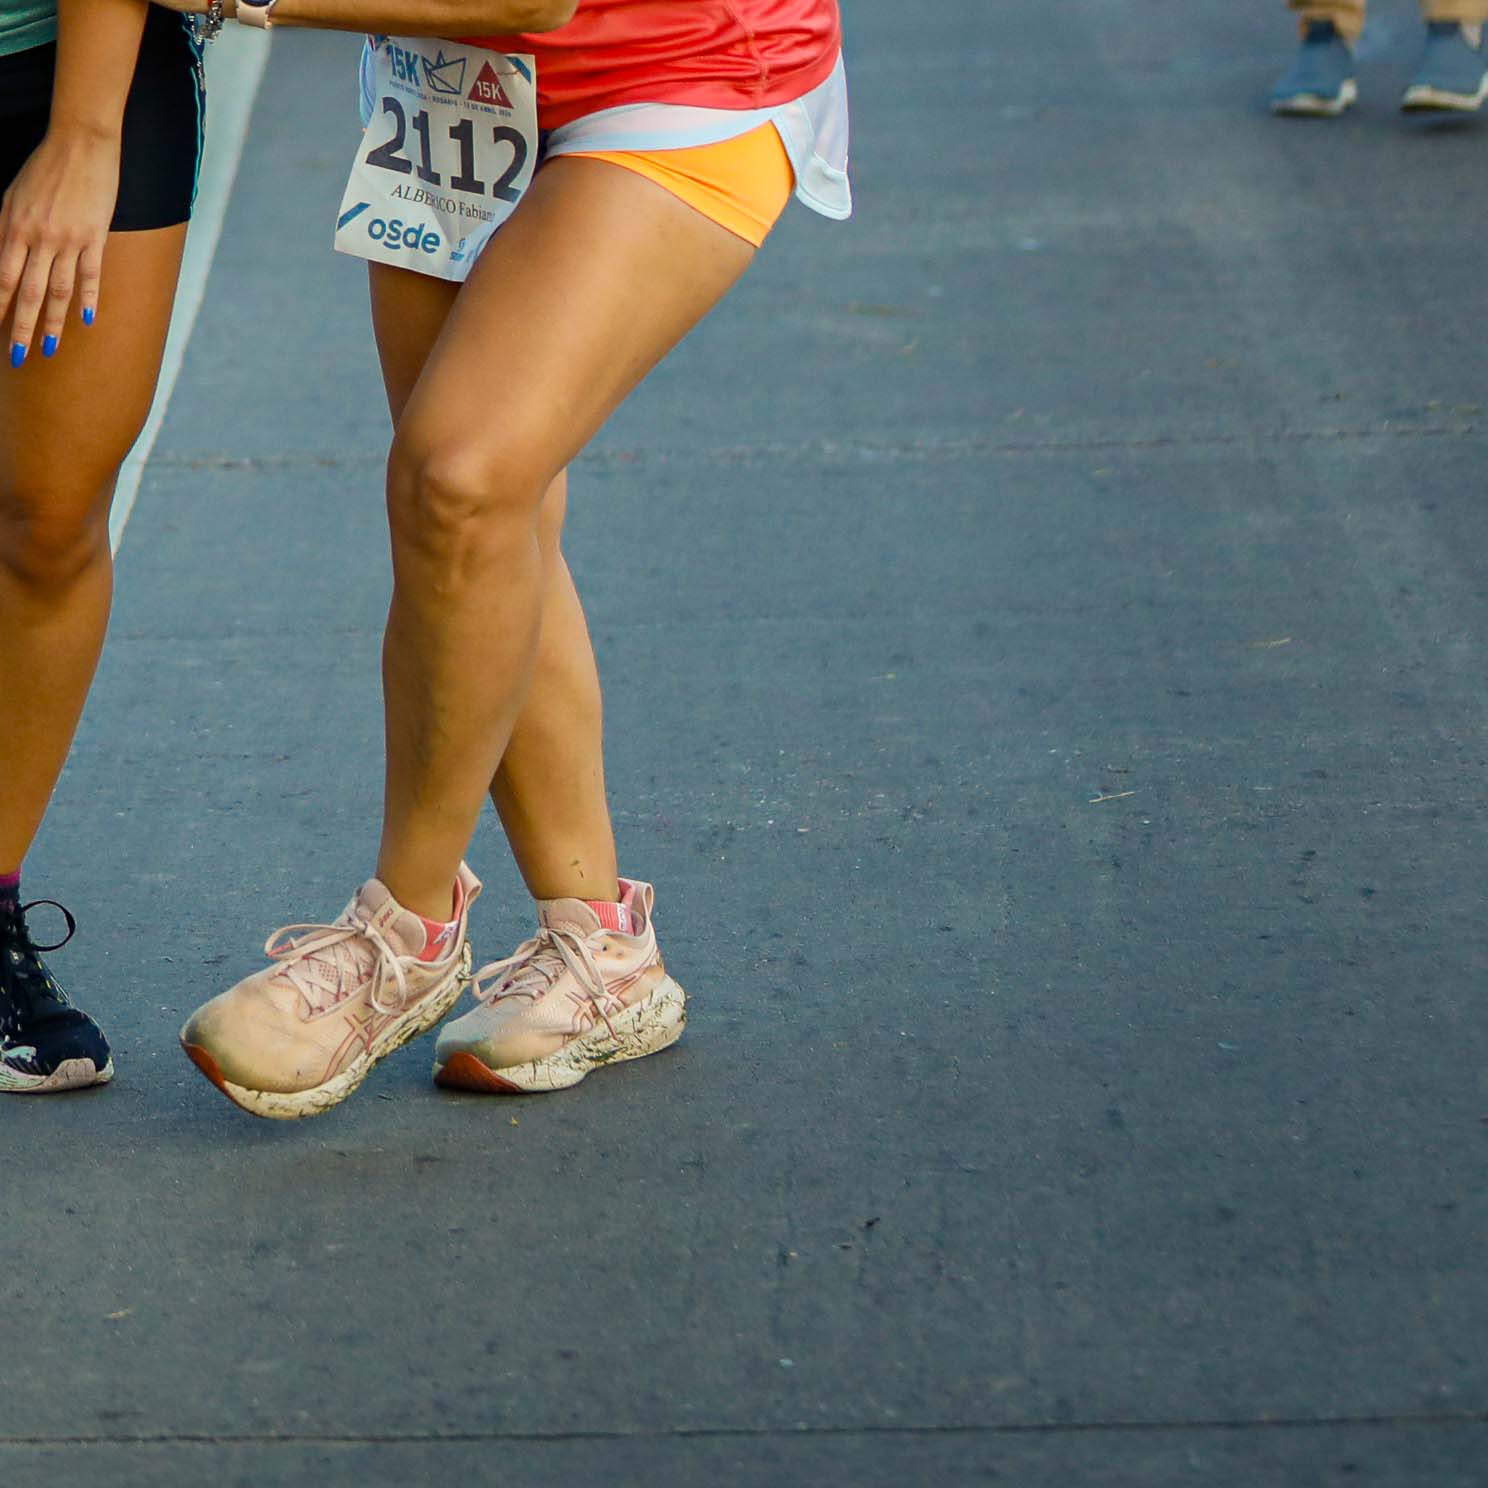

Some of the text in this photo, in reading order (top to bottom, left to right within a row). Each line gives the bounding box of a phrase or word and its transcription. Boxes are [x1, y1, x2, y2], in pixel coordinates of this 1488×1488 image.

[386, 44, 421, 87] 15K
[476, 80, 503, 101] 15K
[365, 96, 528, 203] 2112
[368, 218, 441, 254] osde
